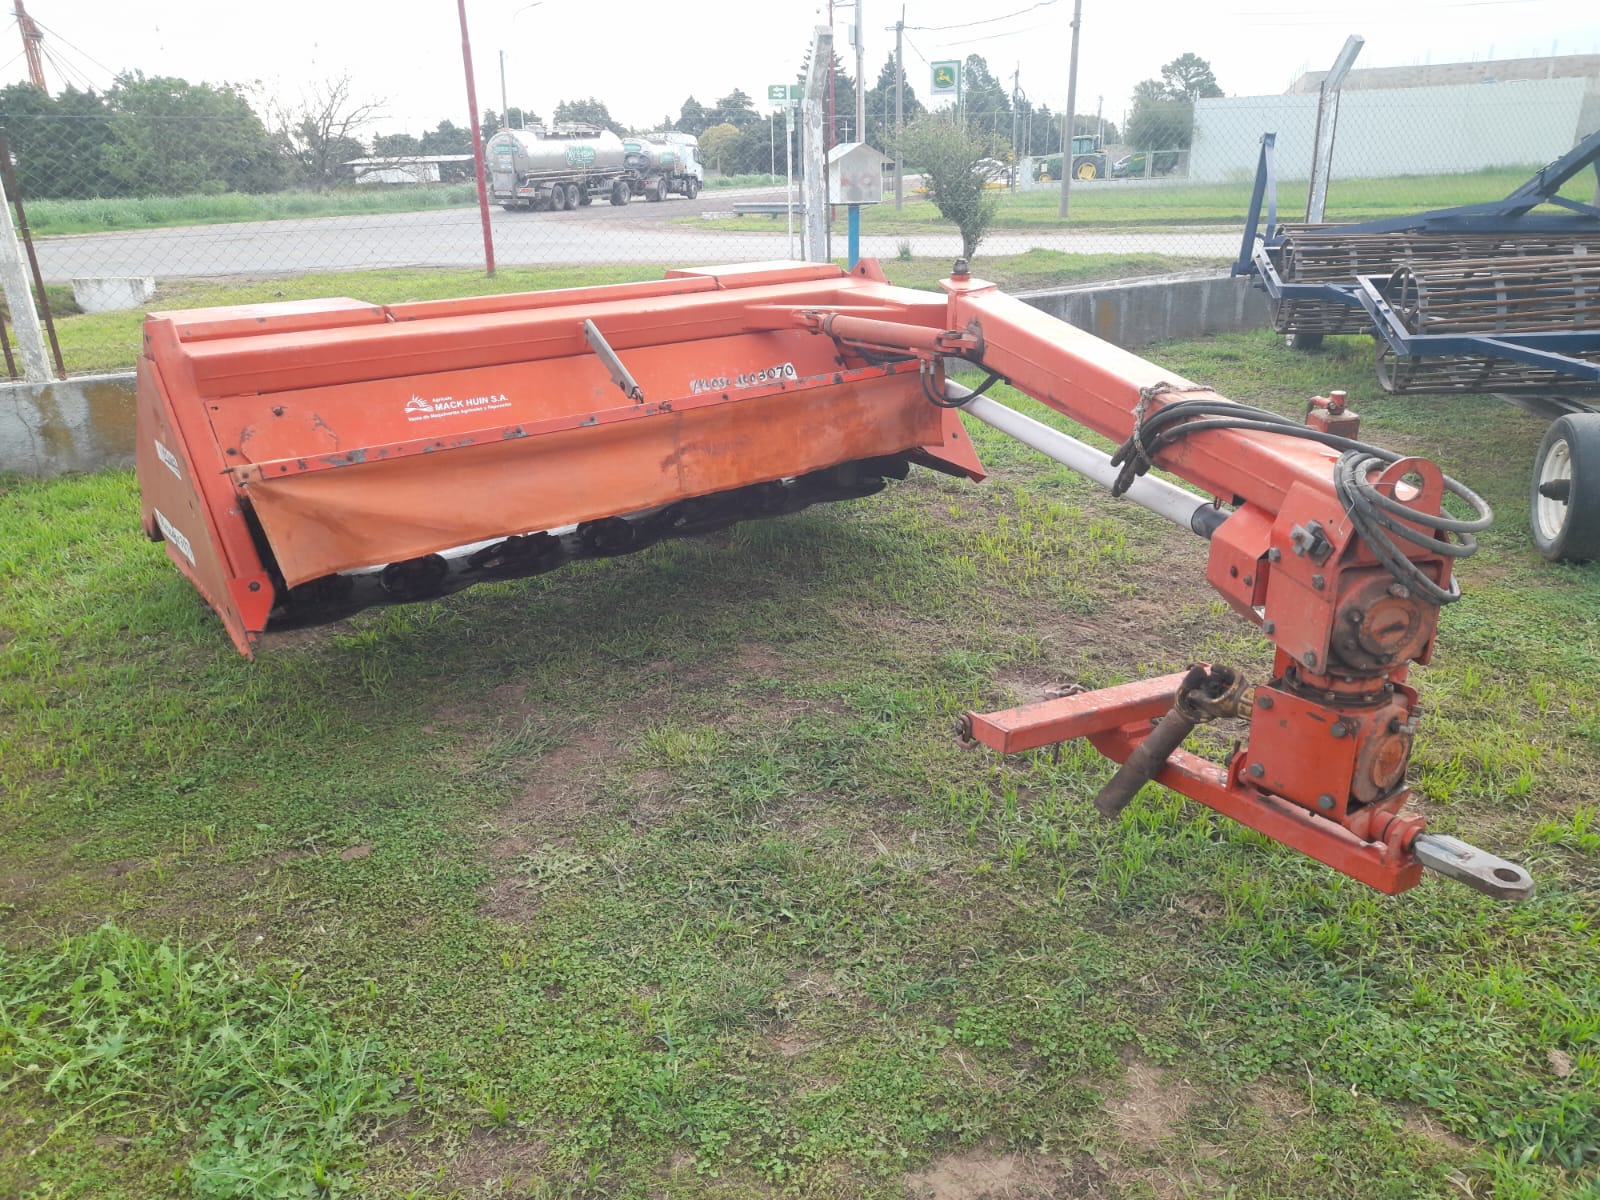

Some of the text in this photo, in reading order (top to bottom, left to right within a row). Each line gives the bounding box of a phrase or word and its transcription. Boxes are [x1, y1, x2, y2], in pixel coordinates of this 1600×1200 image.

[435, 393, 509, 411] MACK HUIN S.A.
